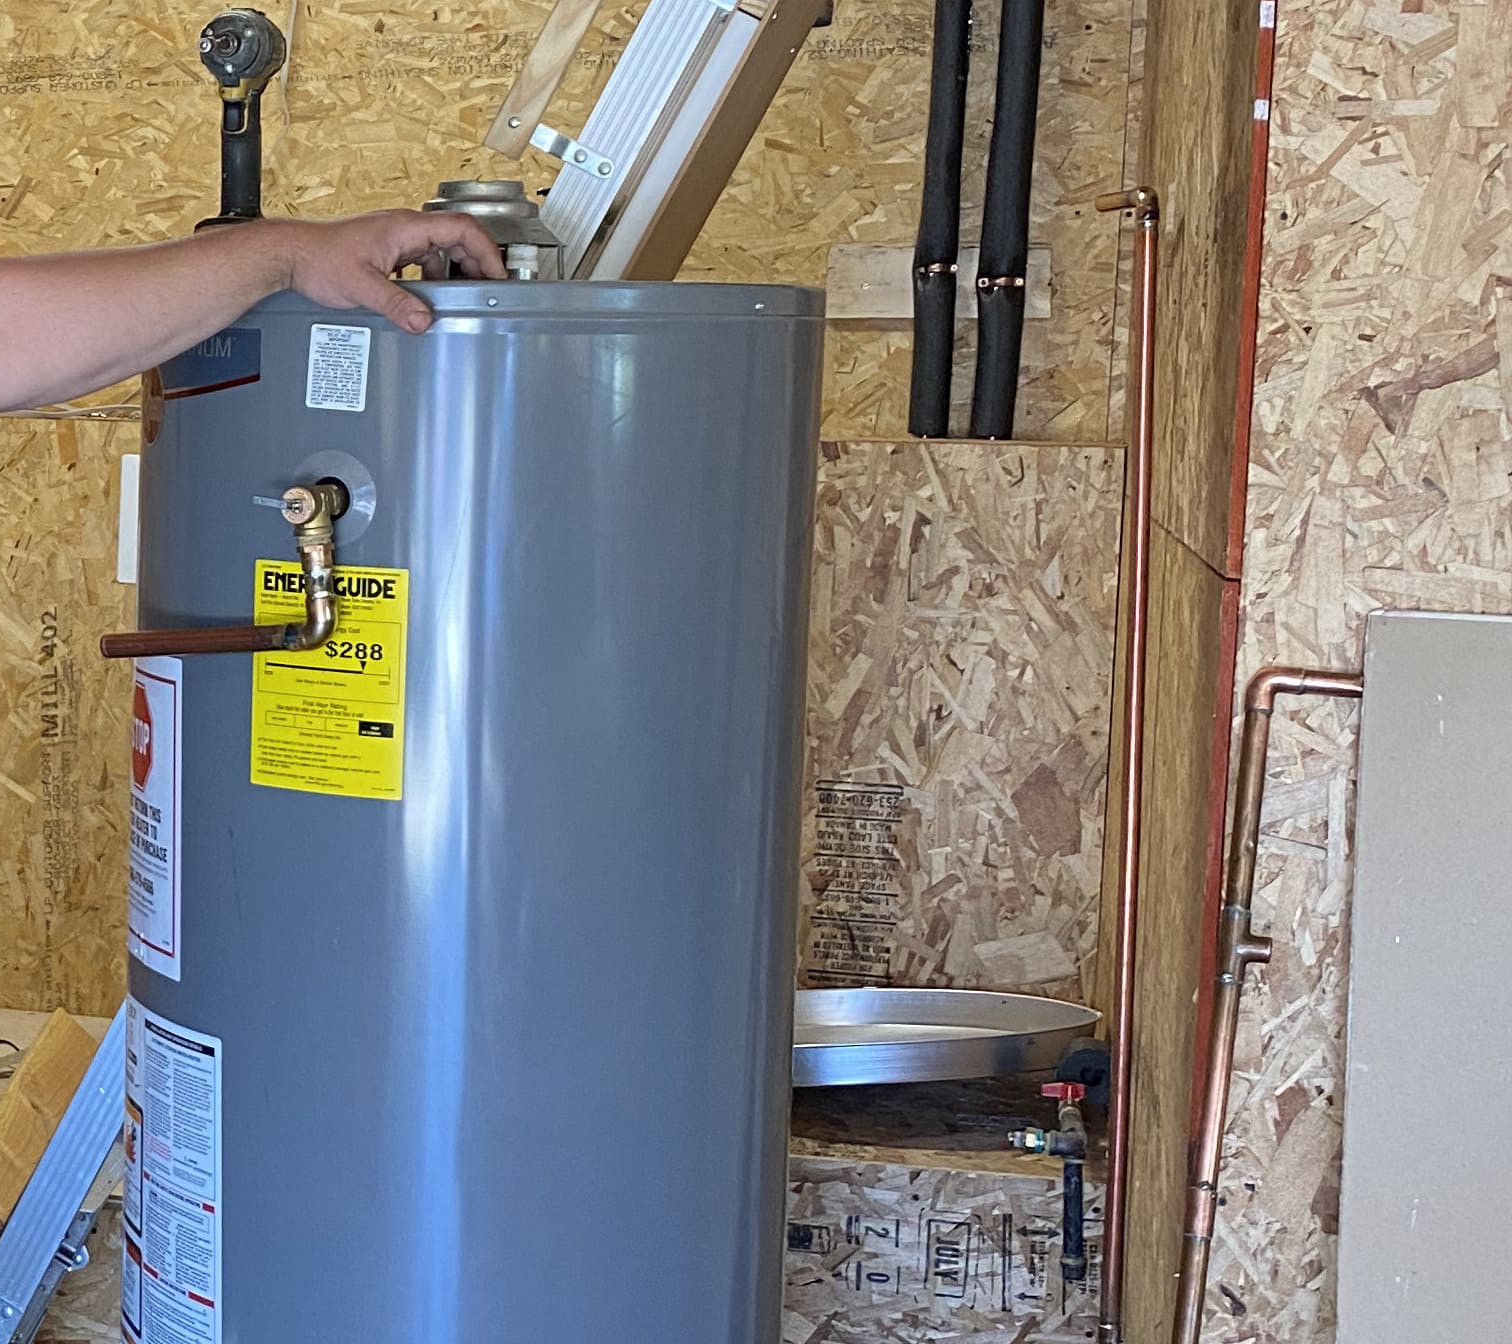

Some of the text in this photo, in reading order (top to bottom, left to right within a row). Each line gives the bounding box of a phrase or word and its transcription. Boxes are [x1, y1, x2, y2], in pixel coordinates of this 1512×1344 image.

[40, 608, 58, 737] MILL 402
[325, 641, 383, 661] $288
[934, 1237, 961, 1282] JULY
